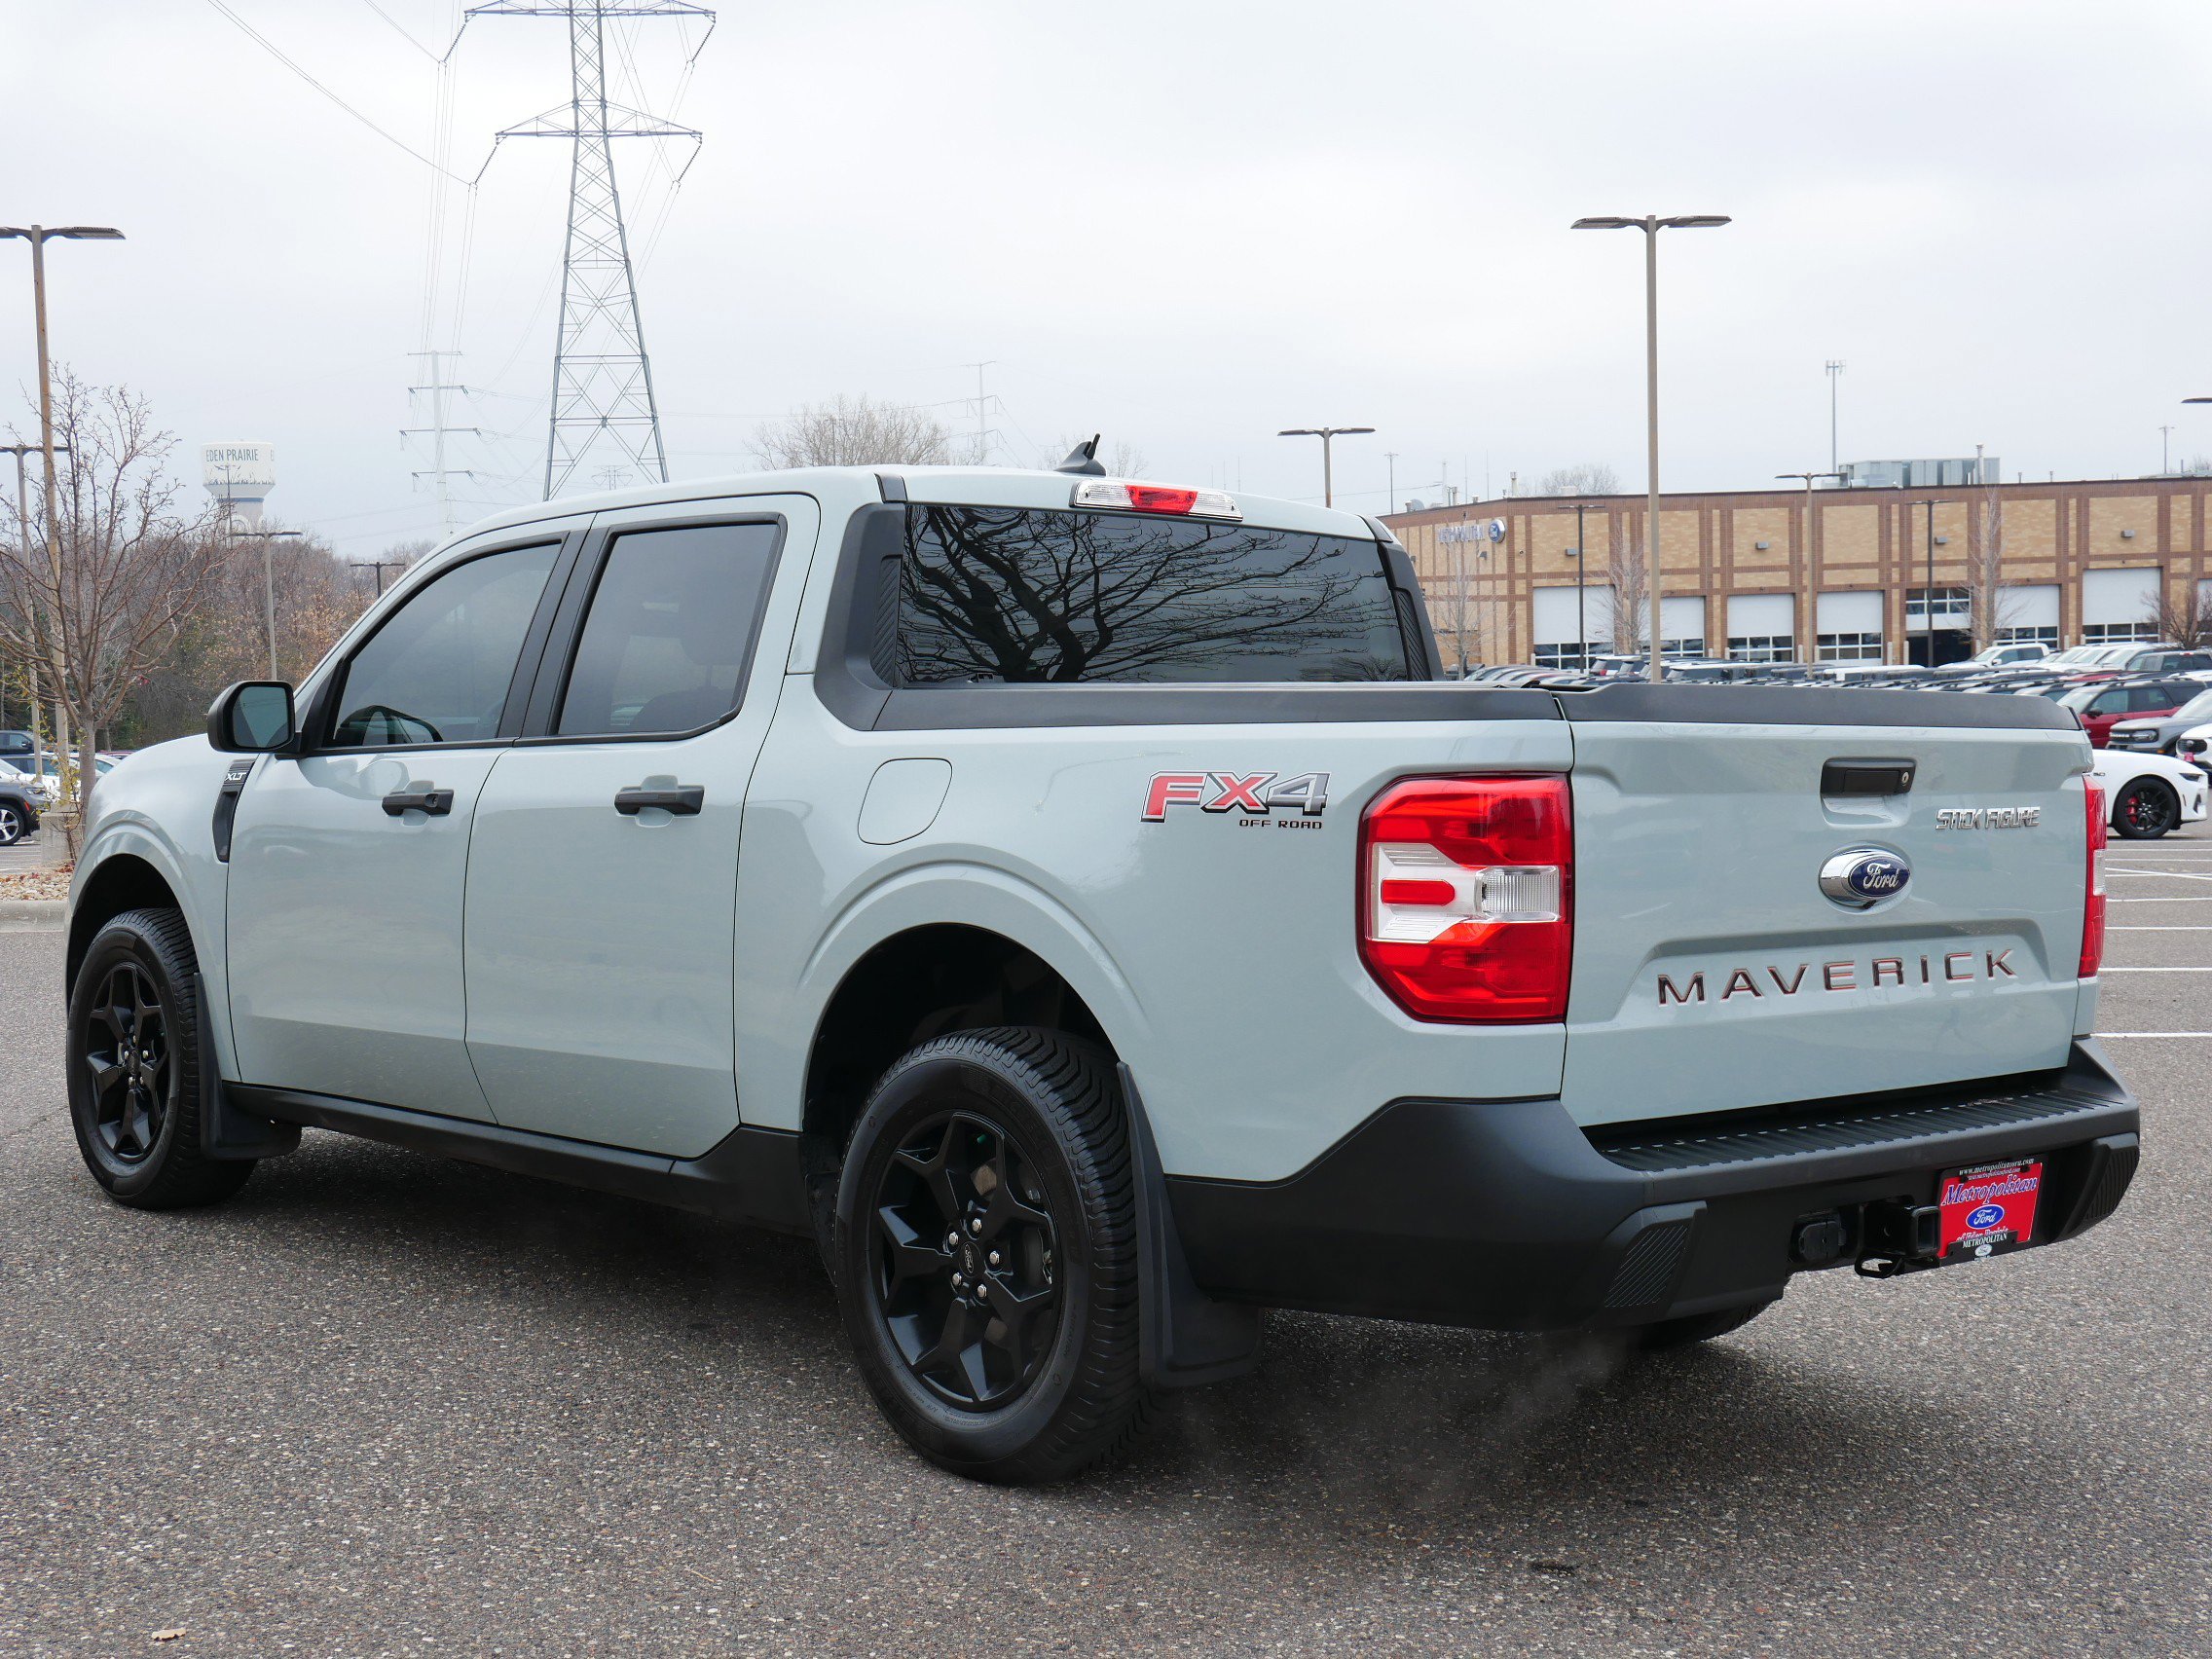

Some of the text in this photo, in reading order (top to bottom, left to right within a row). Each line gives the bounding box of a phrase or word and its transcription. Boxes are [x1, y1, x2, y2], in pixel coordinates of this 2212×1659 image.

[205, 449, 224, 461] EDEN
[227, 448, 259, 461] PRAIRIE
[225, 772, 246, 781] XLT
[1140, 770, 1331, 824] FX4
[1238, 819, 1323, 830] OFF ROAD
[1862, 863, 1900, 889] Ford
[1657, 948, 2018, 1008] MAVERICK
[1940, 1174, 2038, 1206] Metropolitan
[1973, 1209, 1997, 1225] Ford
[1963, 1233, 2007, 1249] METROPOLITAN
